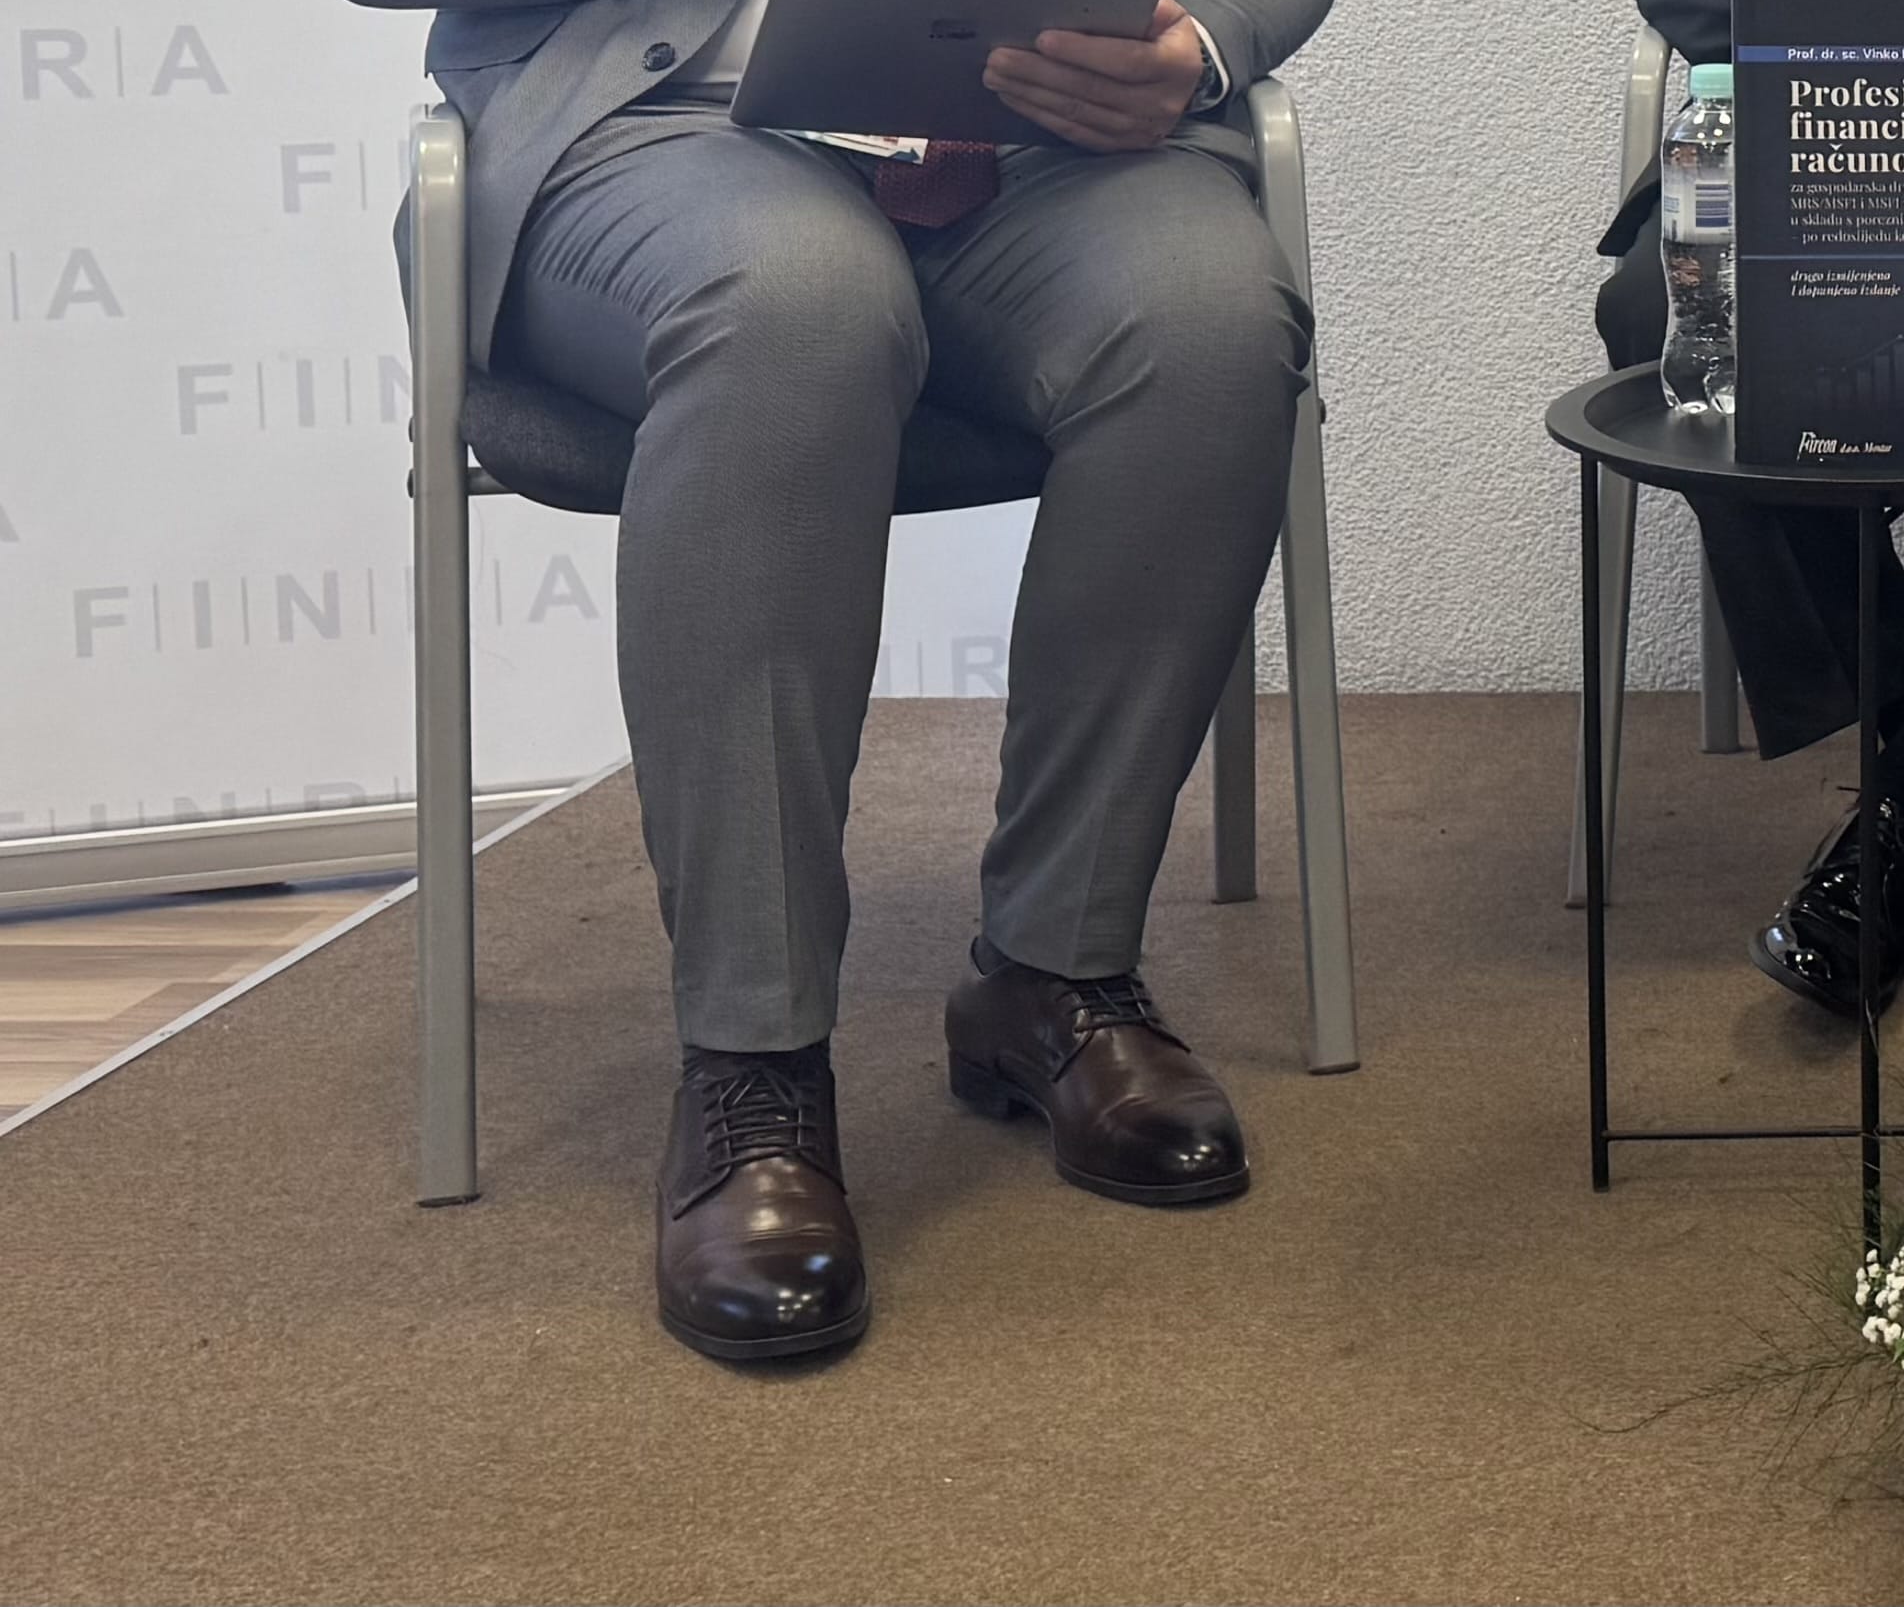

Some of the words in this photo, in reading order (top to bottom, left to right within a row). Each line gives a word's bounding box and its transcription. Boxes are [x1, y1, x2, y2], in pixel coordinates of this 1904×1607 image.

[1788, 48, 1818, 60] Prof.
[1821, 48, 1838, 60] dr.
[1842, 50, 1859, 60] sc.
[1863, 48, 1898, 60] Vinko
[1807, 181, 1886, 195] gospodarska
[1802, 212, 1843, 226] skladu
[1802, 233, 1818, 245] po
[1821, 229, 1892, 244] redoslijedu
[73, 553, 599, 659] FINA
